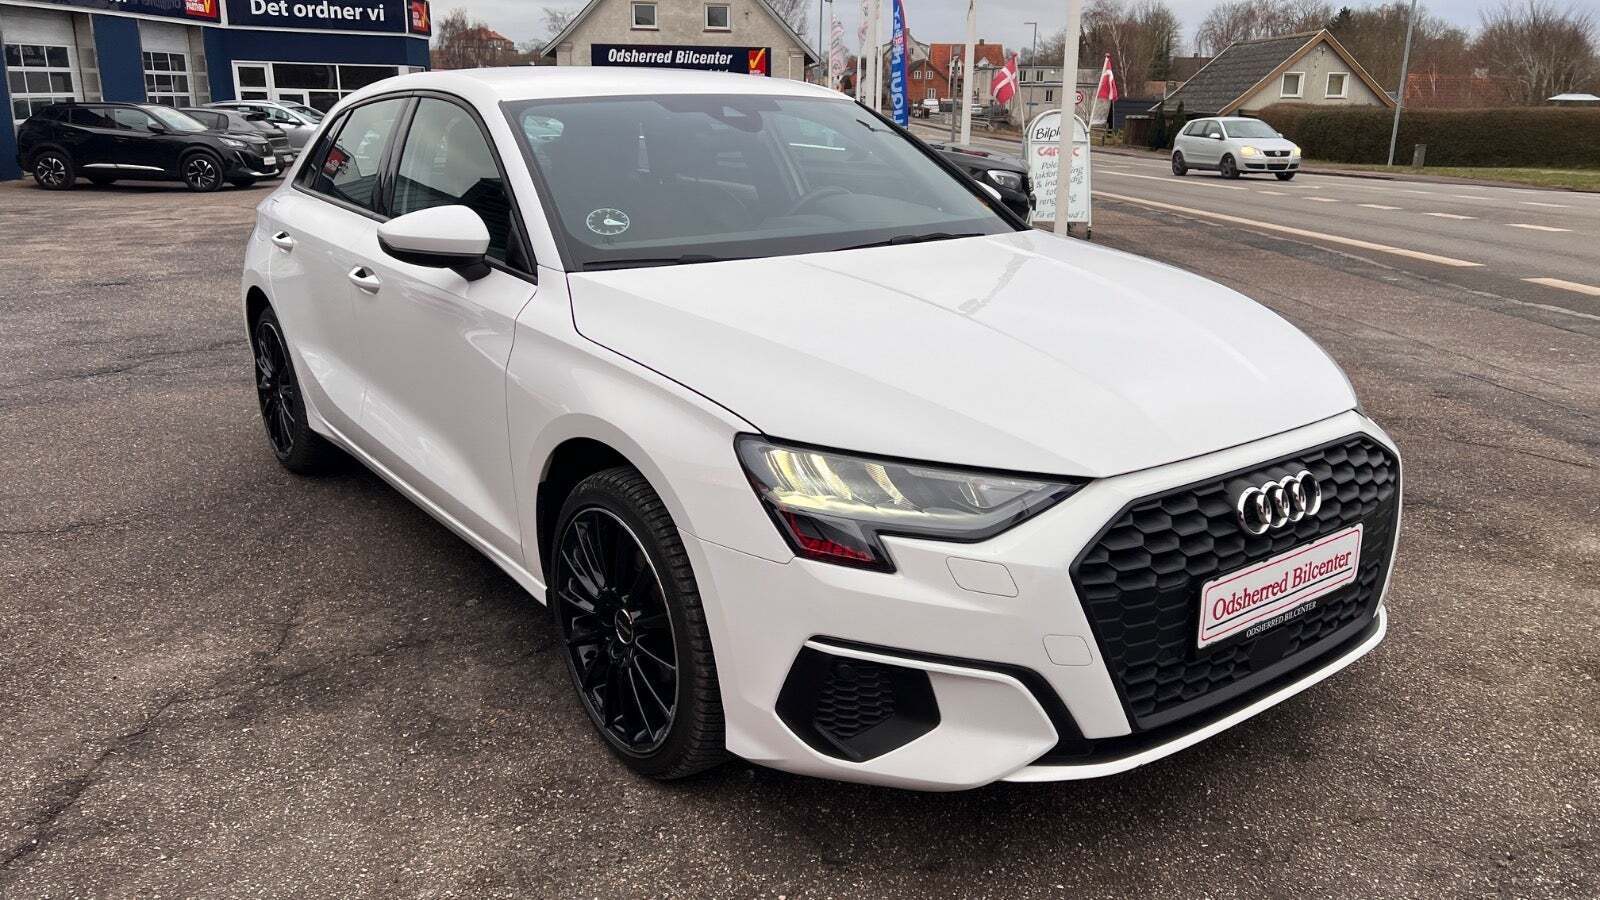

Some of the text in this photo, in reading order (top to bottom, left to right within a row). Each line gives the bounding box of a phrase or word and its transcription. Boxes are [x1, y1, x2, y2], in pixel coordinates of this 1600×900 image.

[250, 0, 385, 22] Det ordner vi
[608, 48, 733, 65] Odsherred Bilcenter
[1035, 126, 1061, 141] Bilpl
[1037, 146, 1080, 157] CARC
[1212, 551, 1352, 621] Odsherred Bilcenter
[1245, 601, 1317, 639] ODSHERRED BILCENTER
